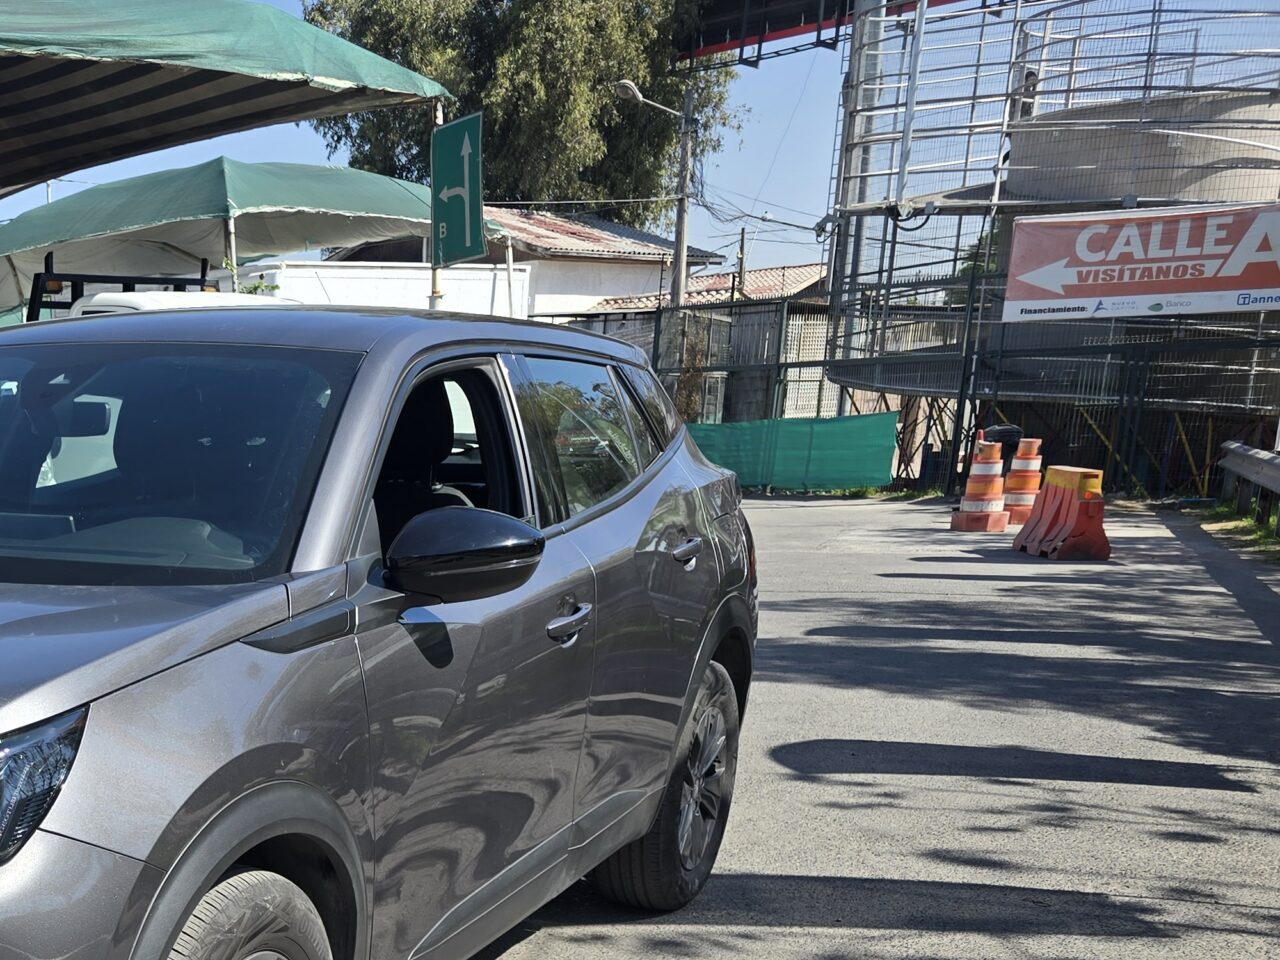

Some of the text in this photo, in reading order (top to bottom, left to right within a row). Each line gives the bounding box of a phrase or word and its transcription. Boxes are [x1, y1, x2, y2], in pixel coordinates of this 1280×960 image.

[439, 222, 447, 239] B
[1075, 215, 1234, 263] CALLE
[1076, 263, 1206, 284] VISÍTANOS
[1020, 305, 1088, 315] Financiamiento:
